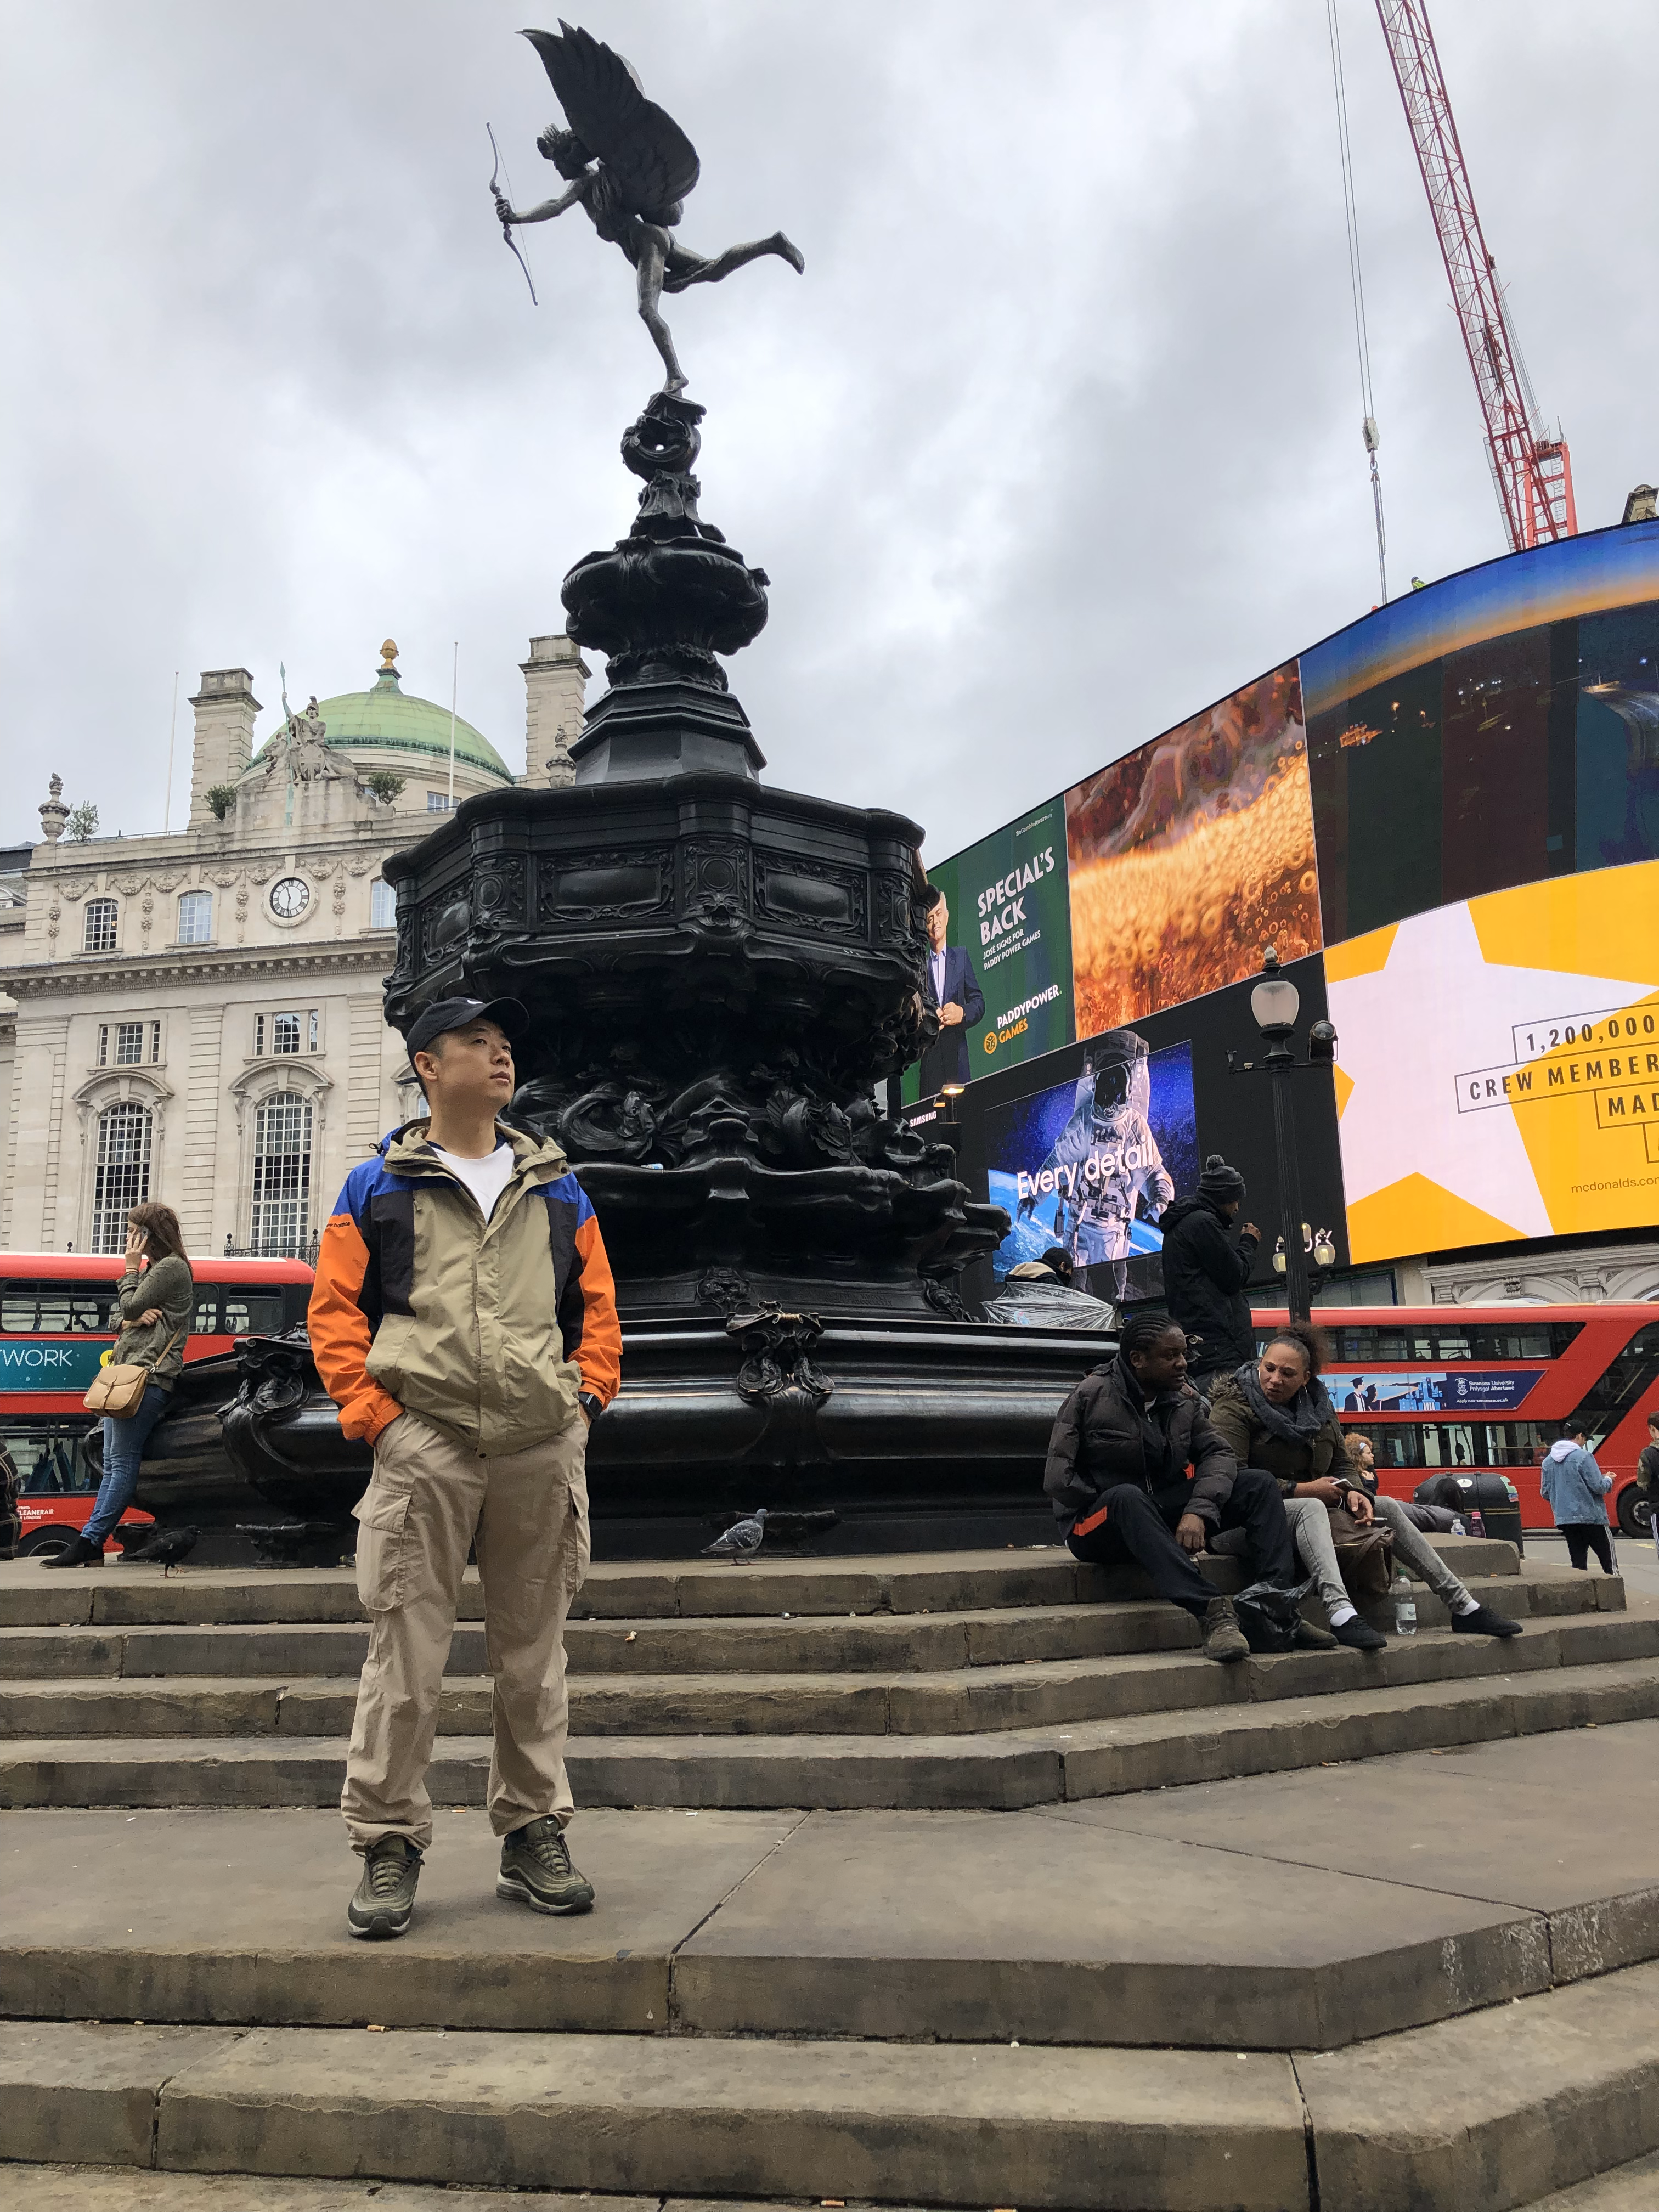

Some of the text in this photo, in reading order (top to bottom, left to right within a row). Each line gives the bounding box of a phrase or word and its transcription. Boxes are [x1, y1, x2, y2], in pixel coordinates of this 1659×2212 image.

[978, 846, 1054, 918] SPECIAL'S
[980, 896, 1027, 946] BACK
[983, 928, 1024, 960] JOSÉ SIGNS FOR
[984, 929, 1041, 970] PADDY POWER GAMES
[998, 1018, 1028, 1043] GAMES
[1526, 1014, 1655, 1053] 1,200,000
[1470, 1071, 1532, 1101] CREW
[910, 1110, 937, 1127] SAMSUNG
[1017, 1135, 1153, 1200] Every detail
[0, 1349, 73, 1367] WORK
